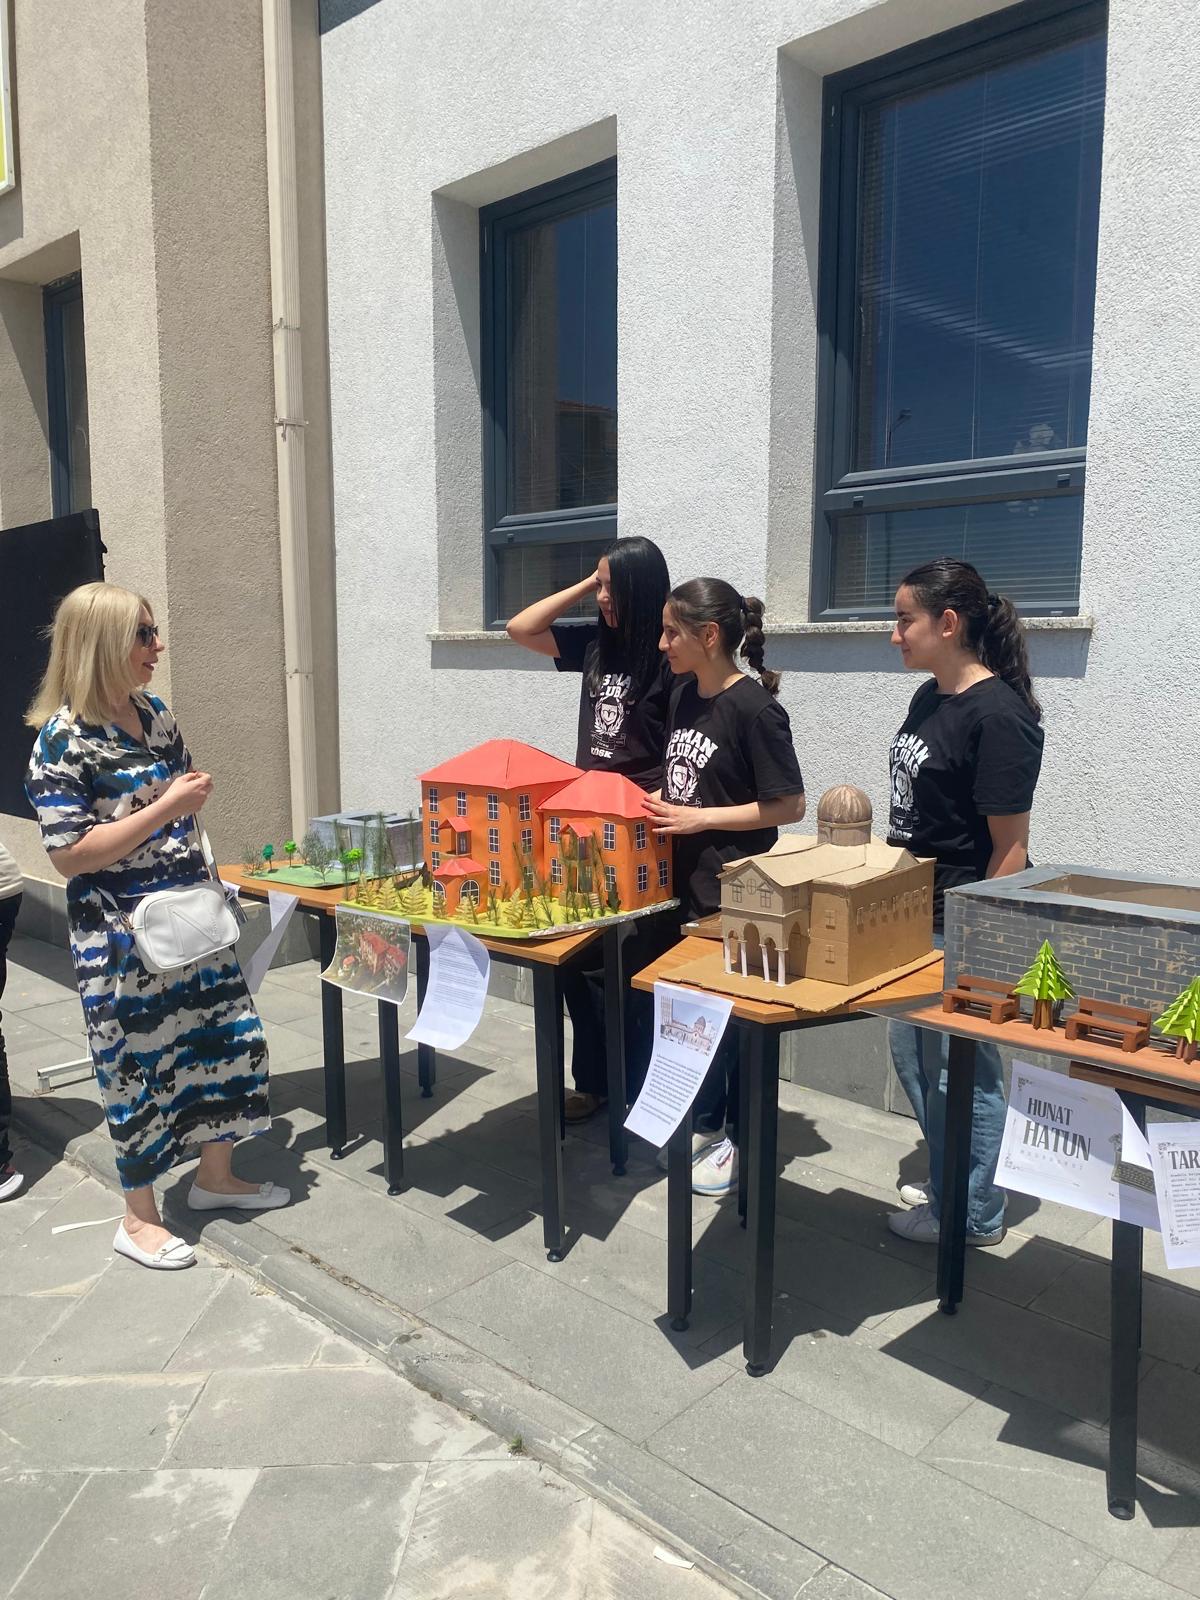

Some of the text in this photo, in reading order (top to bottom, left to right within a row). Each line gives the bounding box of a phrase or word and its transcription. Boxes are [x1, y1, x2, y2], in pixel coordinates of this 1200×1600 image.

[666, 742, 709, 768] LUBAS
[671, 728, 718, 758] SMAN
[890, 747, 919, 778] LUBAS
[1027, 1097, 1073, 1126] HUNAT
[1023, 1119, 1092, 1161] HATUN
